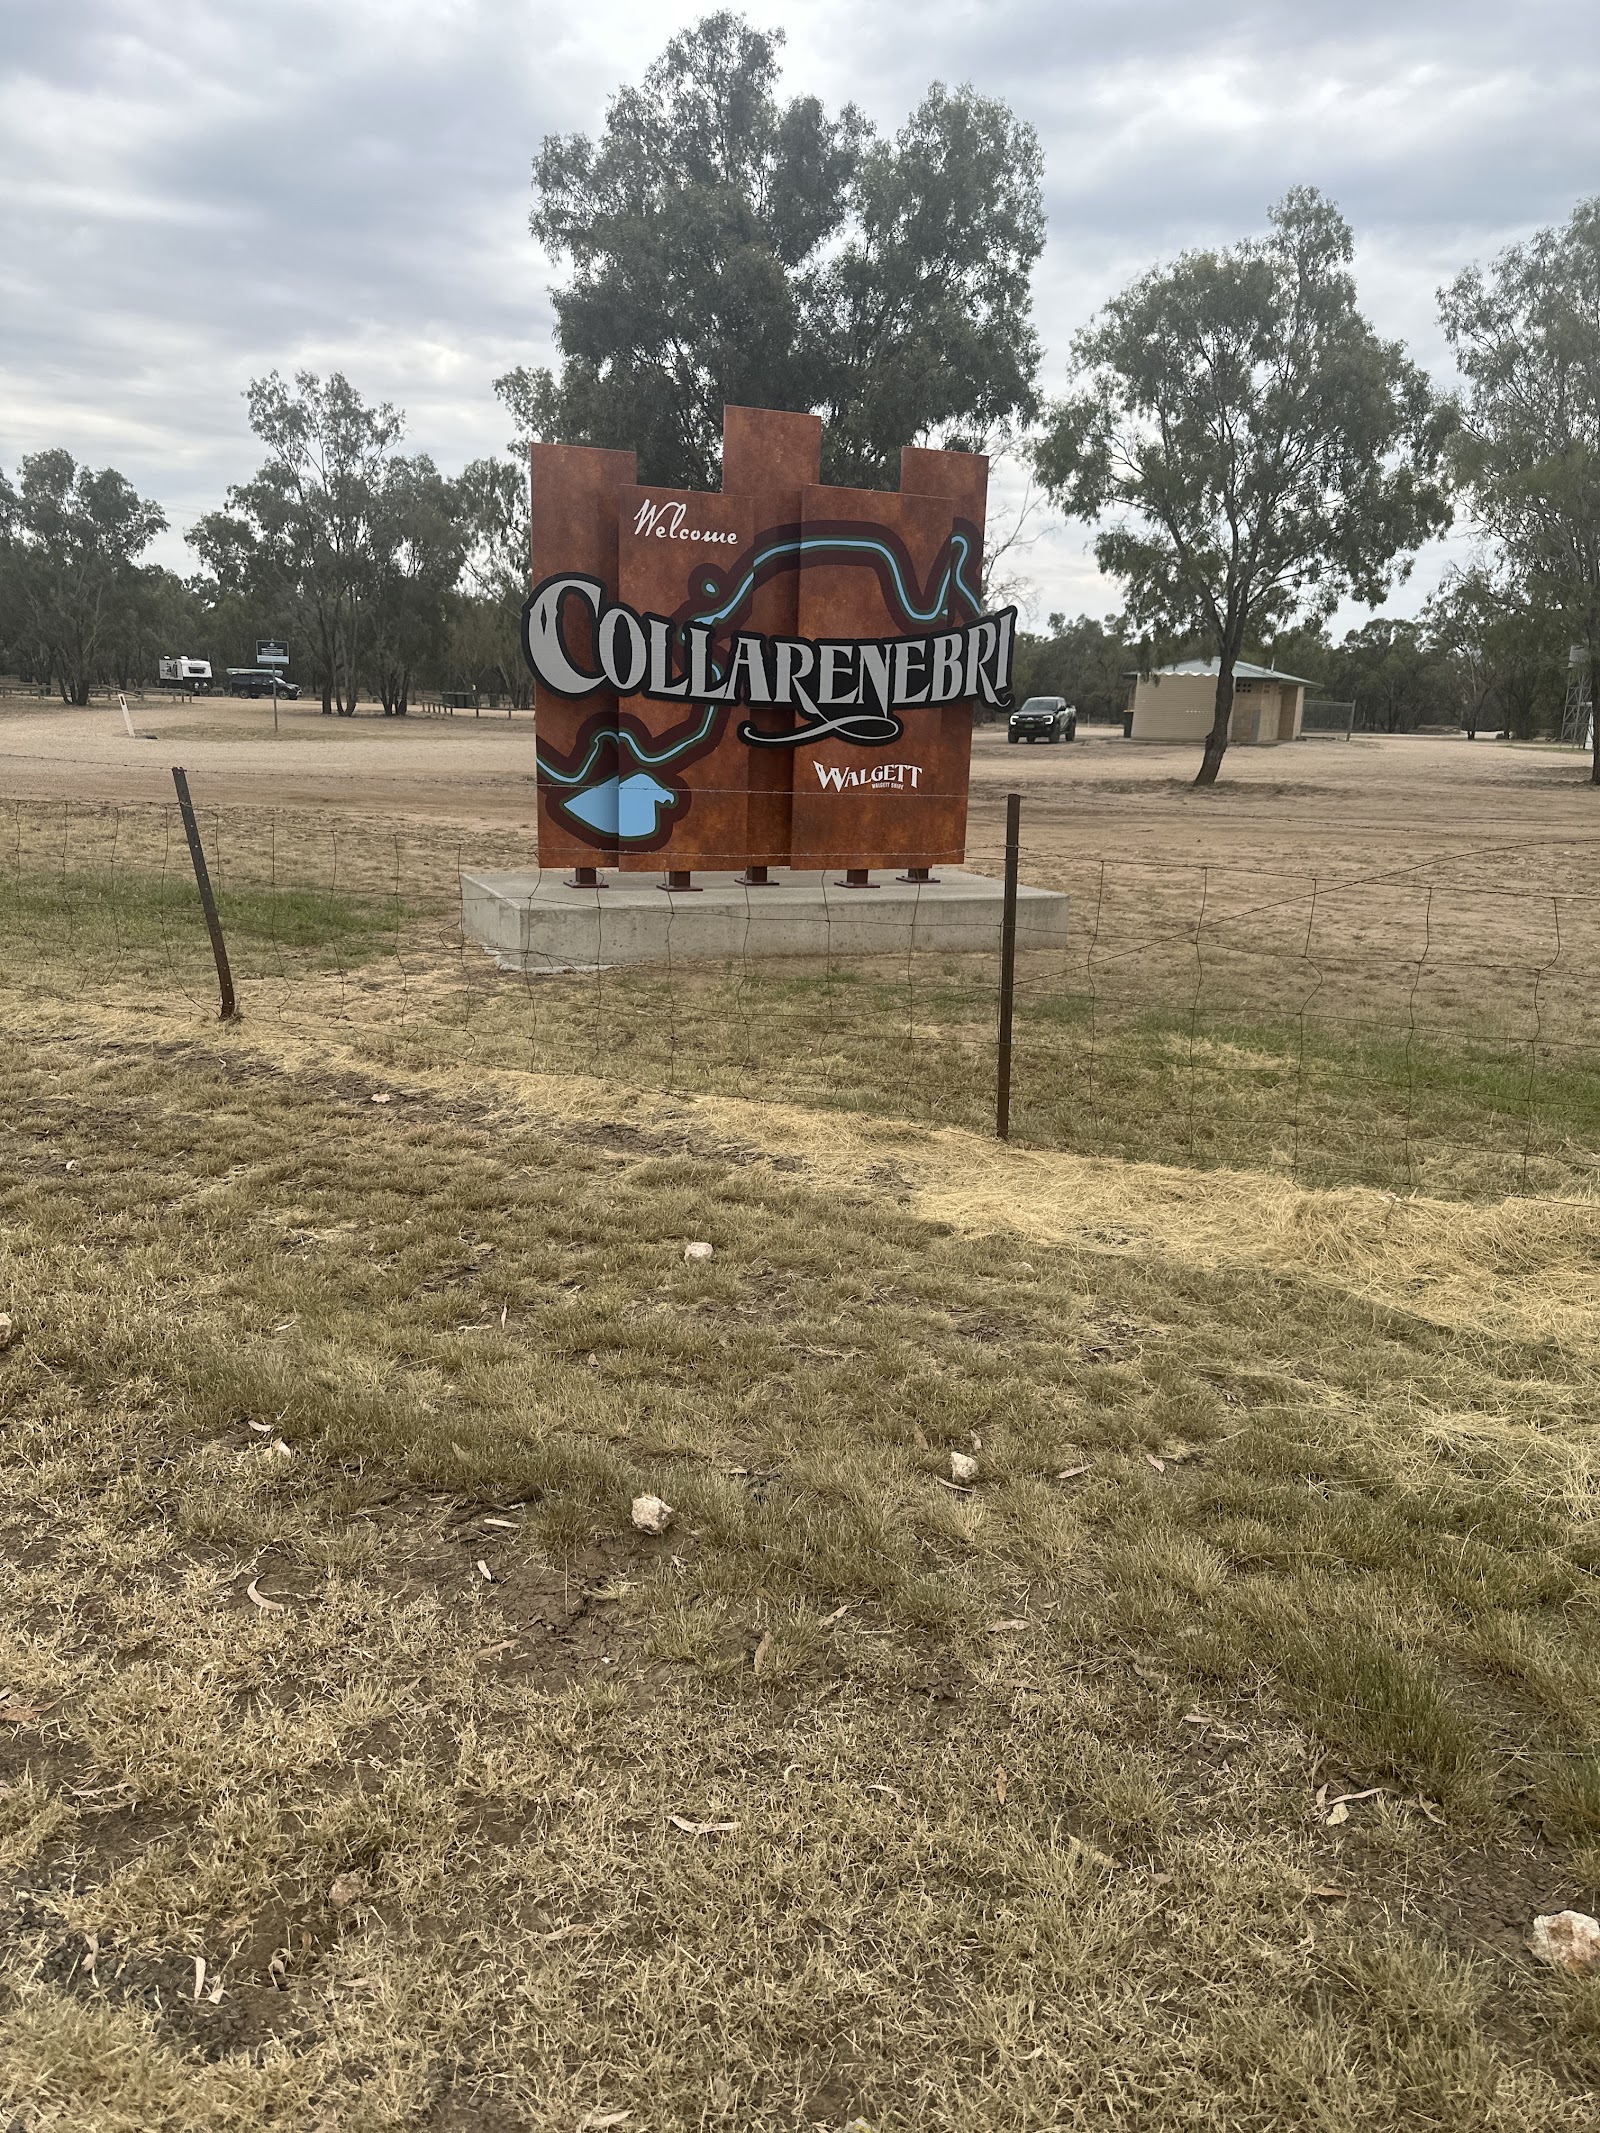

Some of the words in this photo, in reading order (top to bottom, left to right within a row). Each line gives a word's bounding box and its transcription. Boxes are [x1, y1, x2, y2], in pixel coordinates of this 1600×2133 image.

[633, 498, 738, 545] Welcome
[528, 579, 1014, 741] COLLARENEBRI
[812, 760, 923, 793] WALGETT
